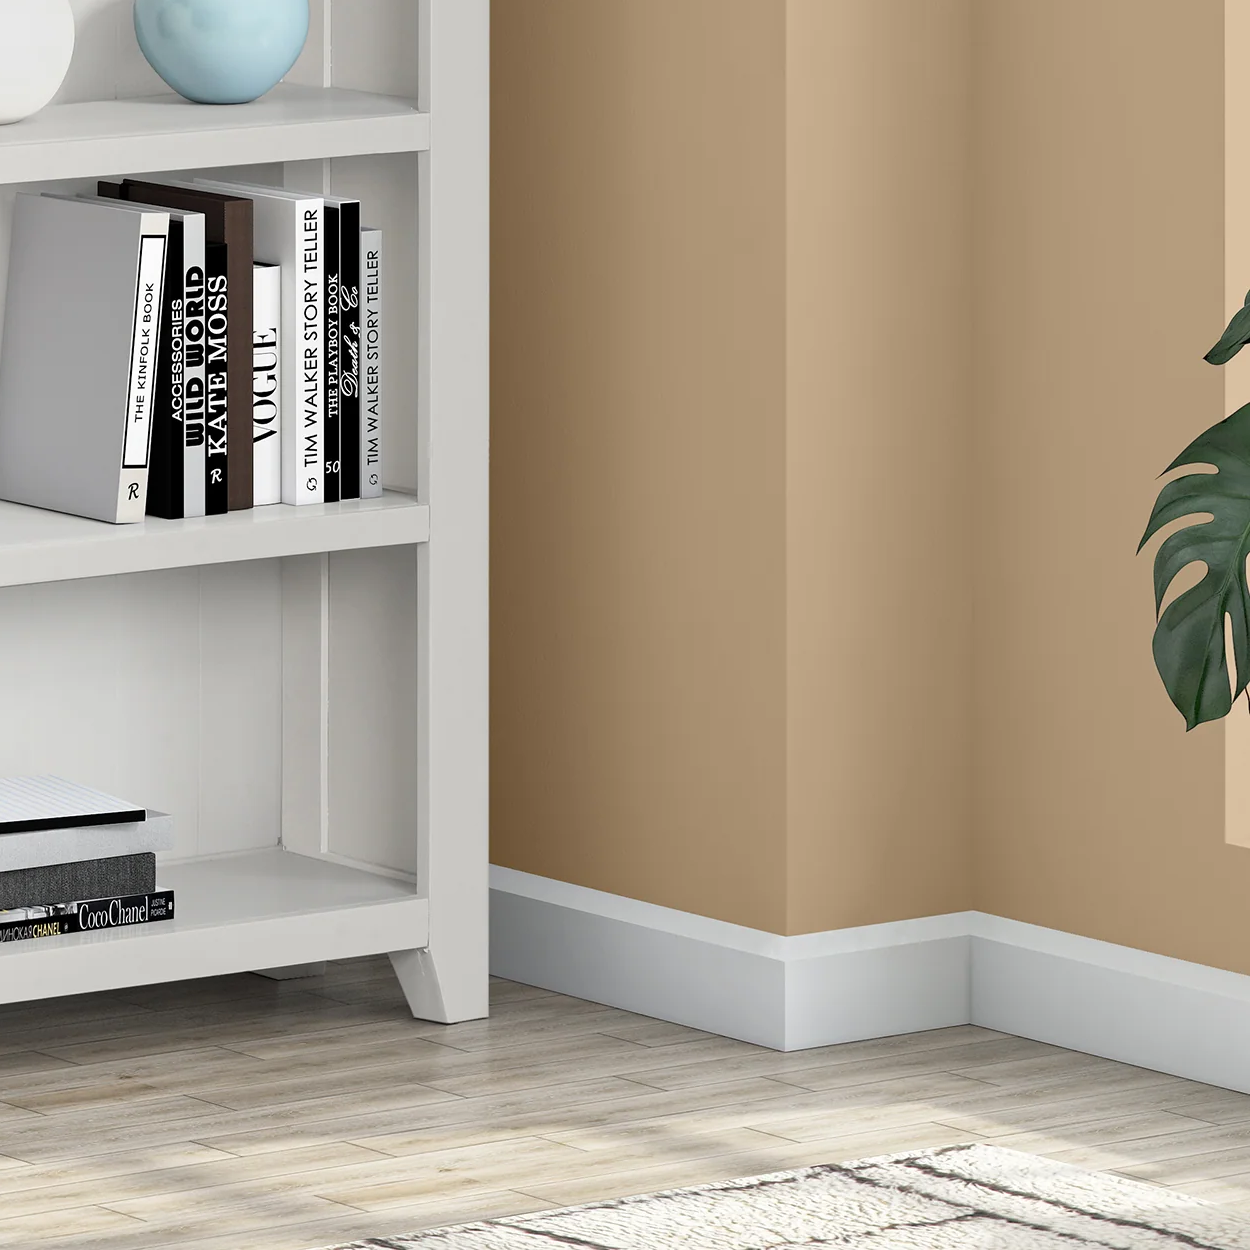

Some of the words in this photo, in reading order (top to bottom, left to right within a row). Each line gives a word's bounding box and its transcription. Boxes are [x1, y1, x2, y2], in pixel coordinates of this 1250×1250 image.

[304, 209, 318, 273] TELLER
[143, 283, 154, 323] BOOK
[328, 273, 338, 314] BOOK
[340, 285, 359, 311] Co
[367, 250, 379, 304] TELLER
[185, 266, 205, 368] WORLD
[208, 275, 227, 364] MOSS
[304, 279, 318, 341] STORY
[367, 309, 379, 360] STORY
[137, 329, 151, 390] KINFOLK
[171, 299, 183, 422] ACCESSORIES
[328, 318, 338, 386] PLAYBOY
[340, 335, 359, 398] Death
[134, 395, 145, 423] THE
[185, 377, 205, 447] WILD
[208, 371, 227, 457] KATE
[253, 328, 278, 443] VOGUE
[304, 347, 318, 428] WALKER
[328, 388, 338, 418] THE
[367, 365, 379, 433] WALKER
[304, 434, 318, 468] TIM
[325, 460, 340, 474] 50
[367, 438, 379, 466] TIM
[32, 921, 62, 938] CHANEL
[79, 903, 108, 930] Coco
[108, 895, 149, 926] Chanel
